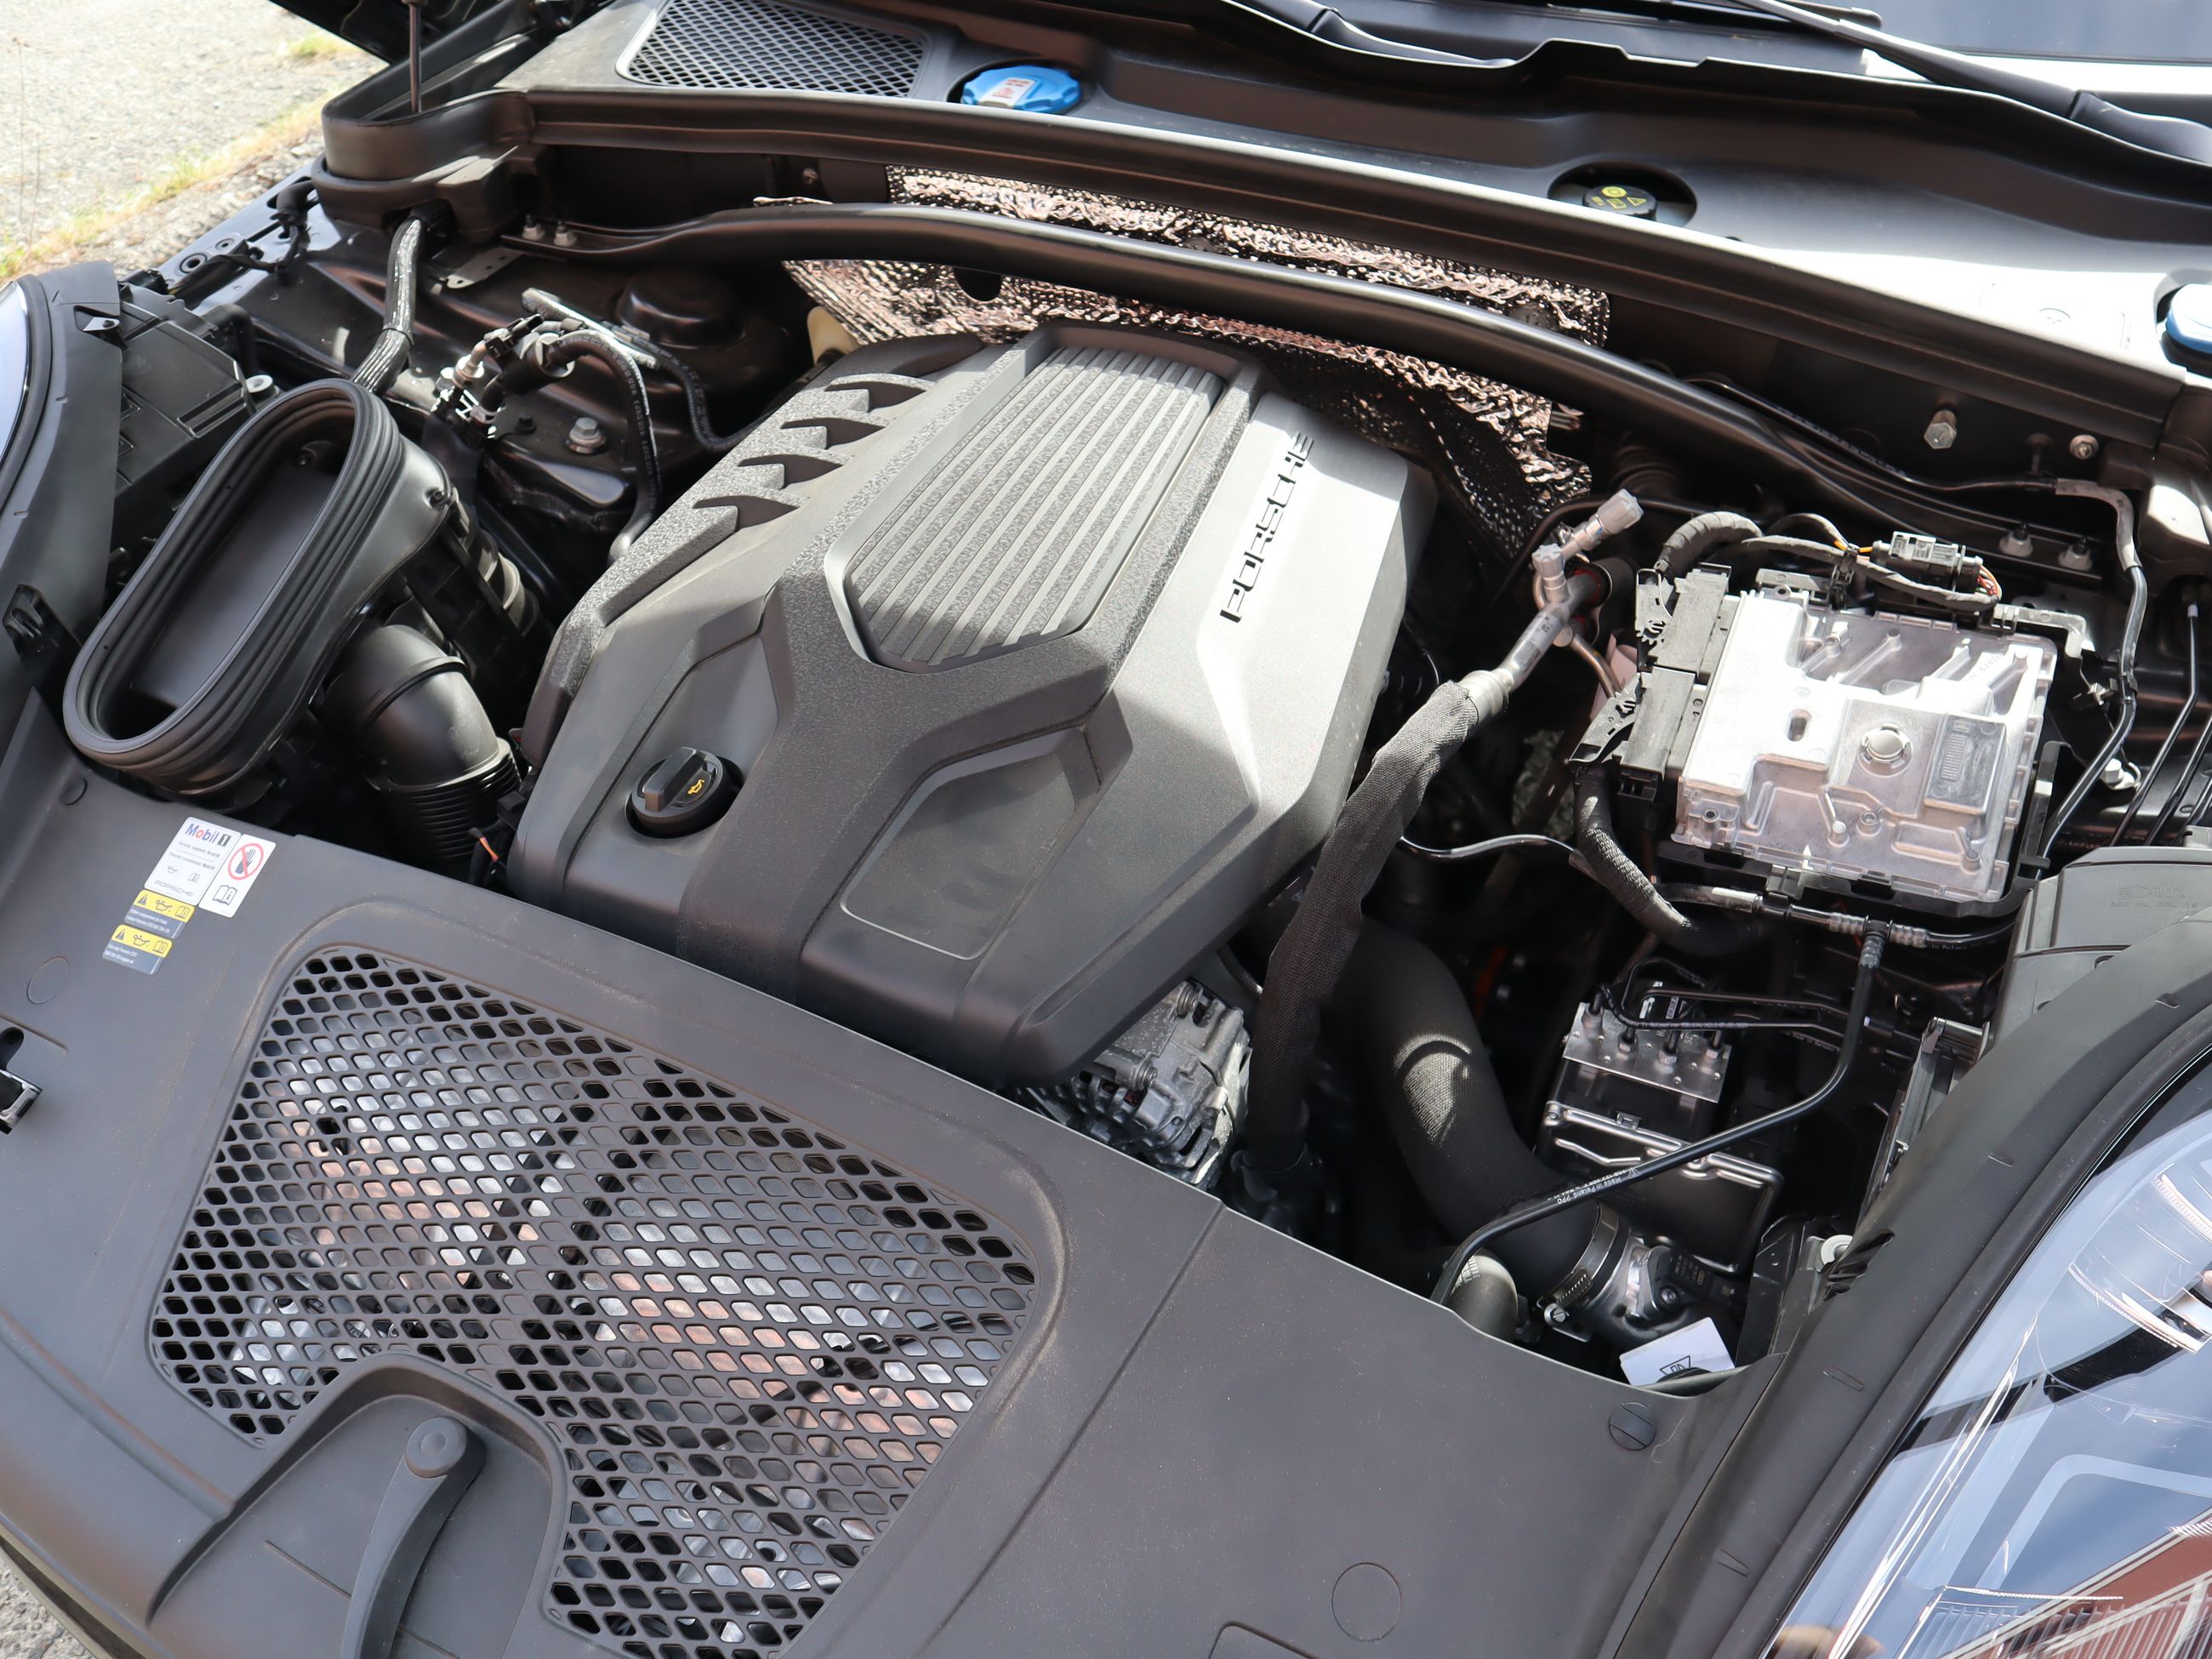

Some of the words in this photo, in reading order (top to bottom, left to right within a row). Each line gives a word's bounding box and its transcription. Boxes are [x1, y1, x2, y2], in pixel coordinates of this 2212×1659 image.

[1220, 430, 1314, 623] PORSCHE
[185, 824, 219, 844] Mobil
[217, 834, 232, 847] 1
[1573, 1185, 1597, 1199] Poland
